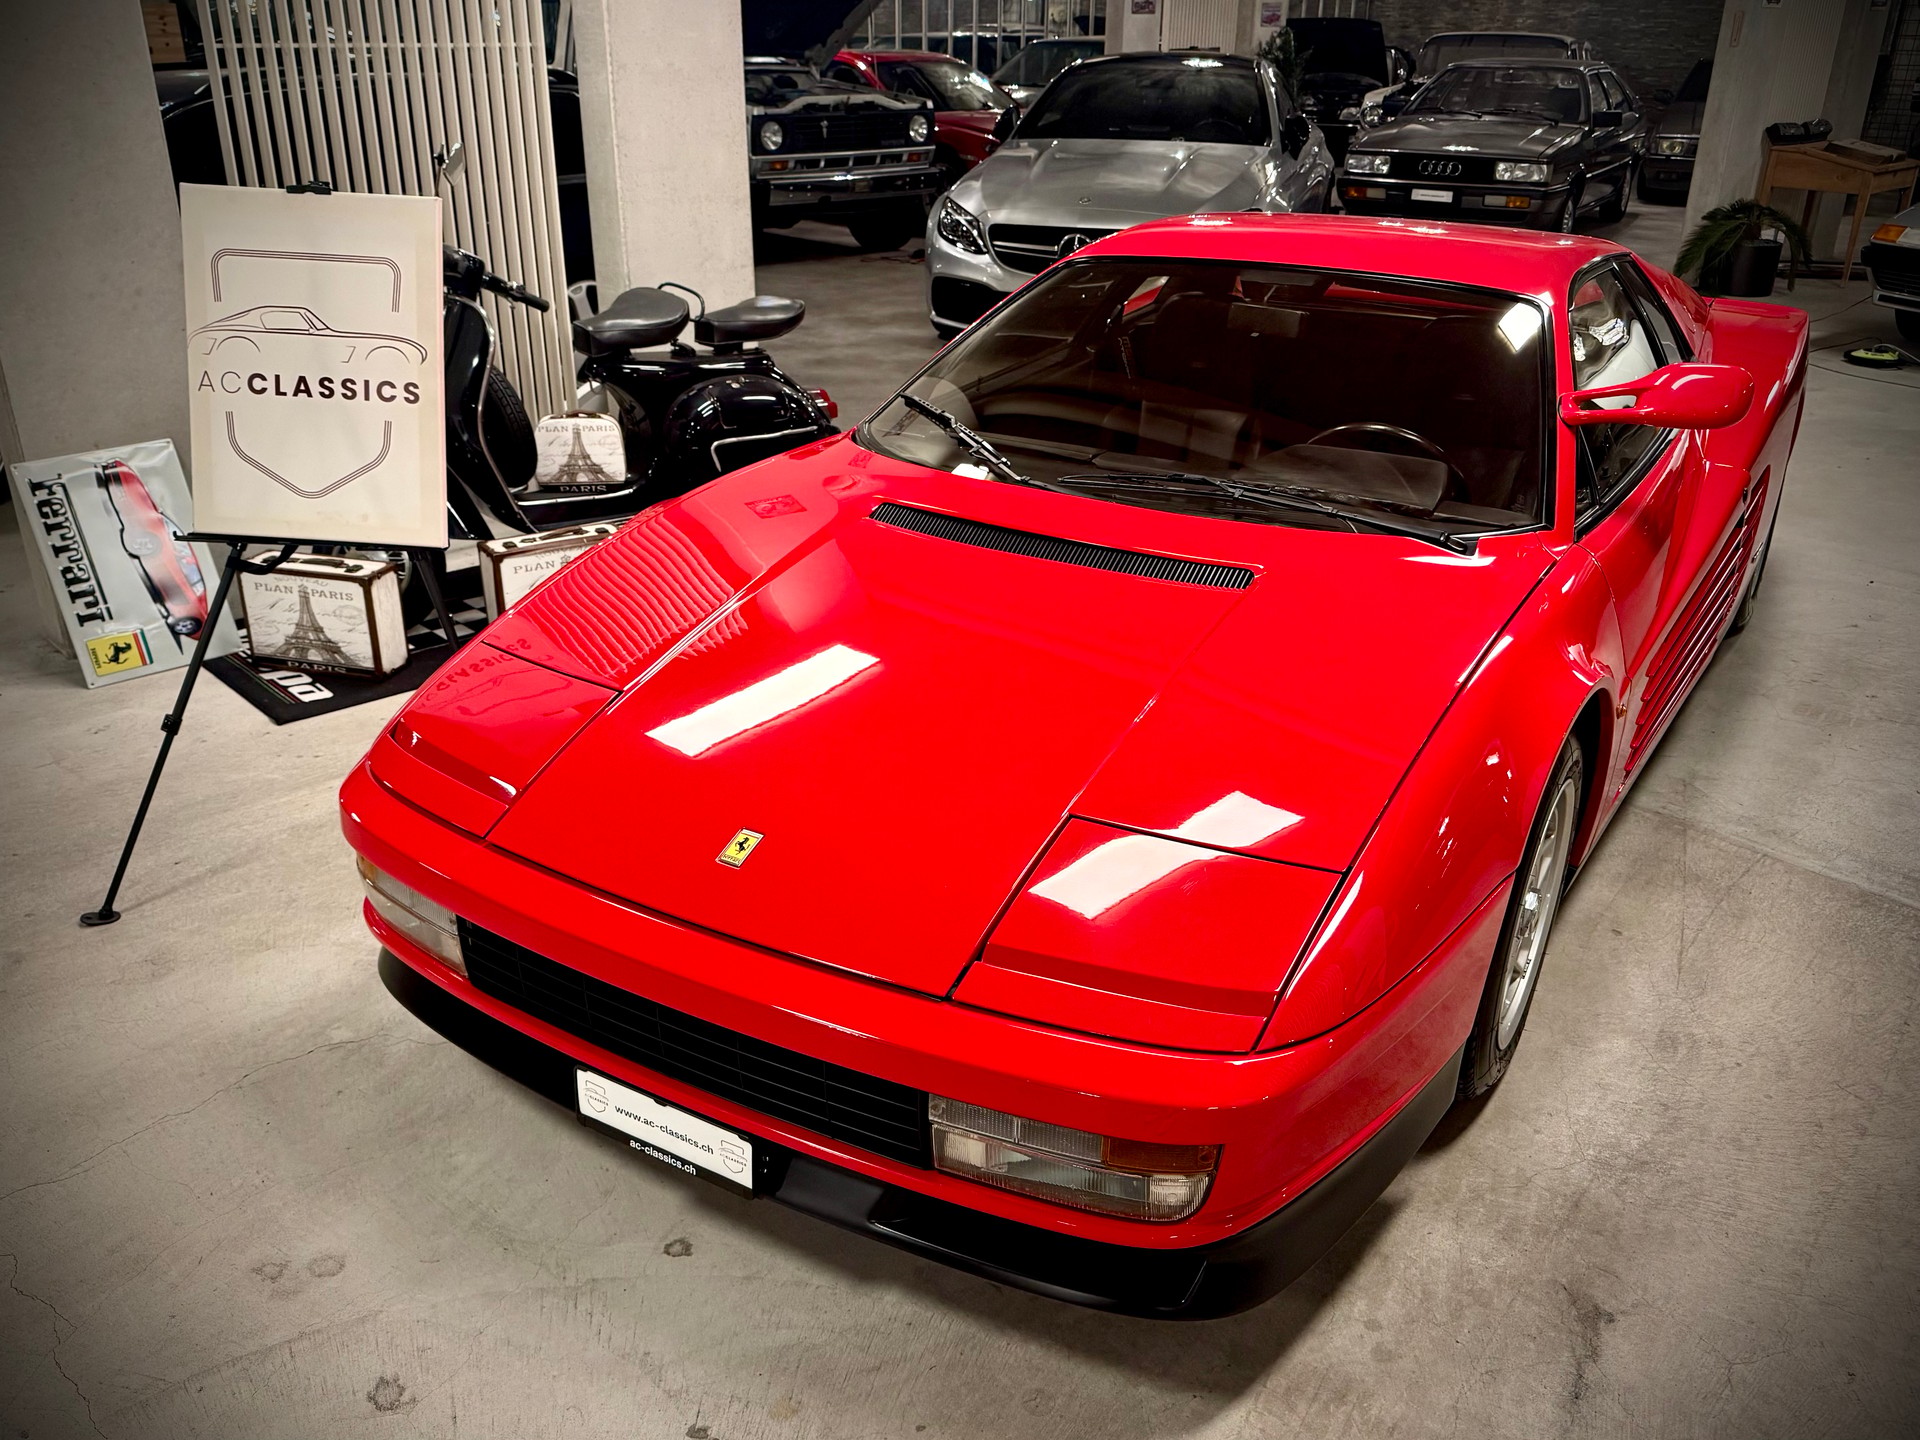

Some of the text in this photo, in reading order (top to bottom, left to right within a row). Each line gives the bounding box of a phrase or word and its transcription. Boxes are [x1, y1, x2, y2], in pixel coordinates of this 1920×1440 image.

[538, 424, 615, 433] PLAN PARIS
[560, 485, 607, 493] PARIS
[26, 473, 114, 627] Ferrari
[513, 560, 556, 575] PLAN
[254, 582, 354, 602] PLAN PARIS
[287, 660, 347, 674] PARIS
[614, 1105, 715, 1155] www.ac-classics.ch
[629, 1139, 697, 1176] ac-classics.ch
